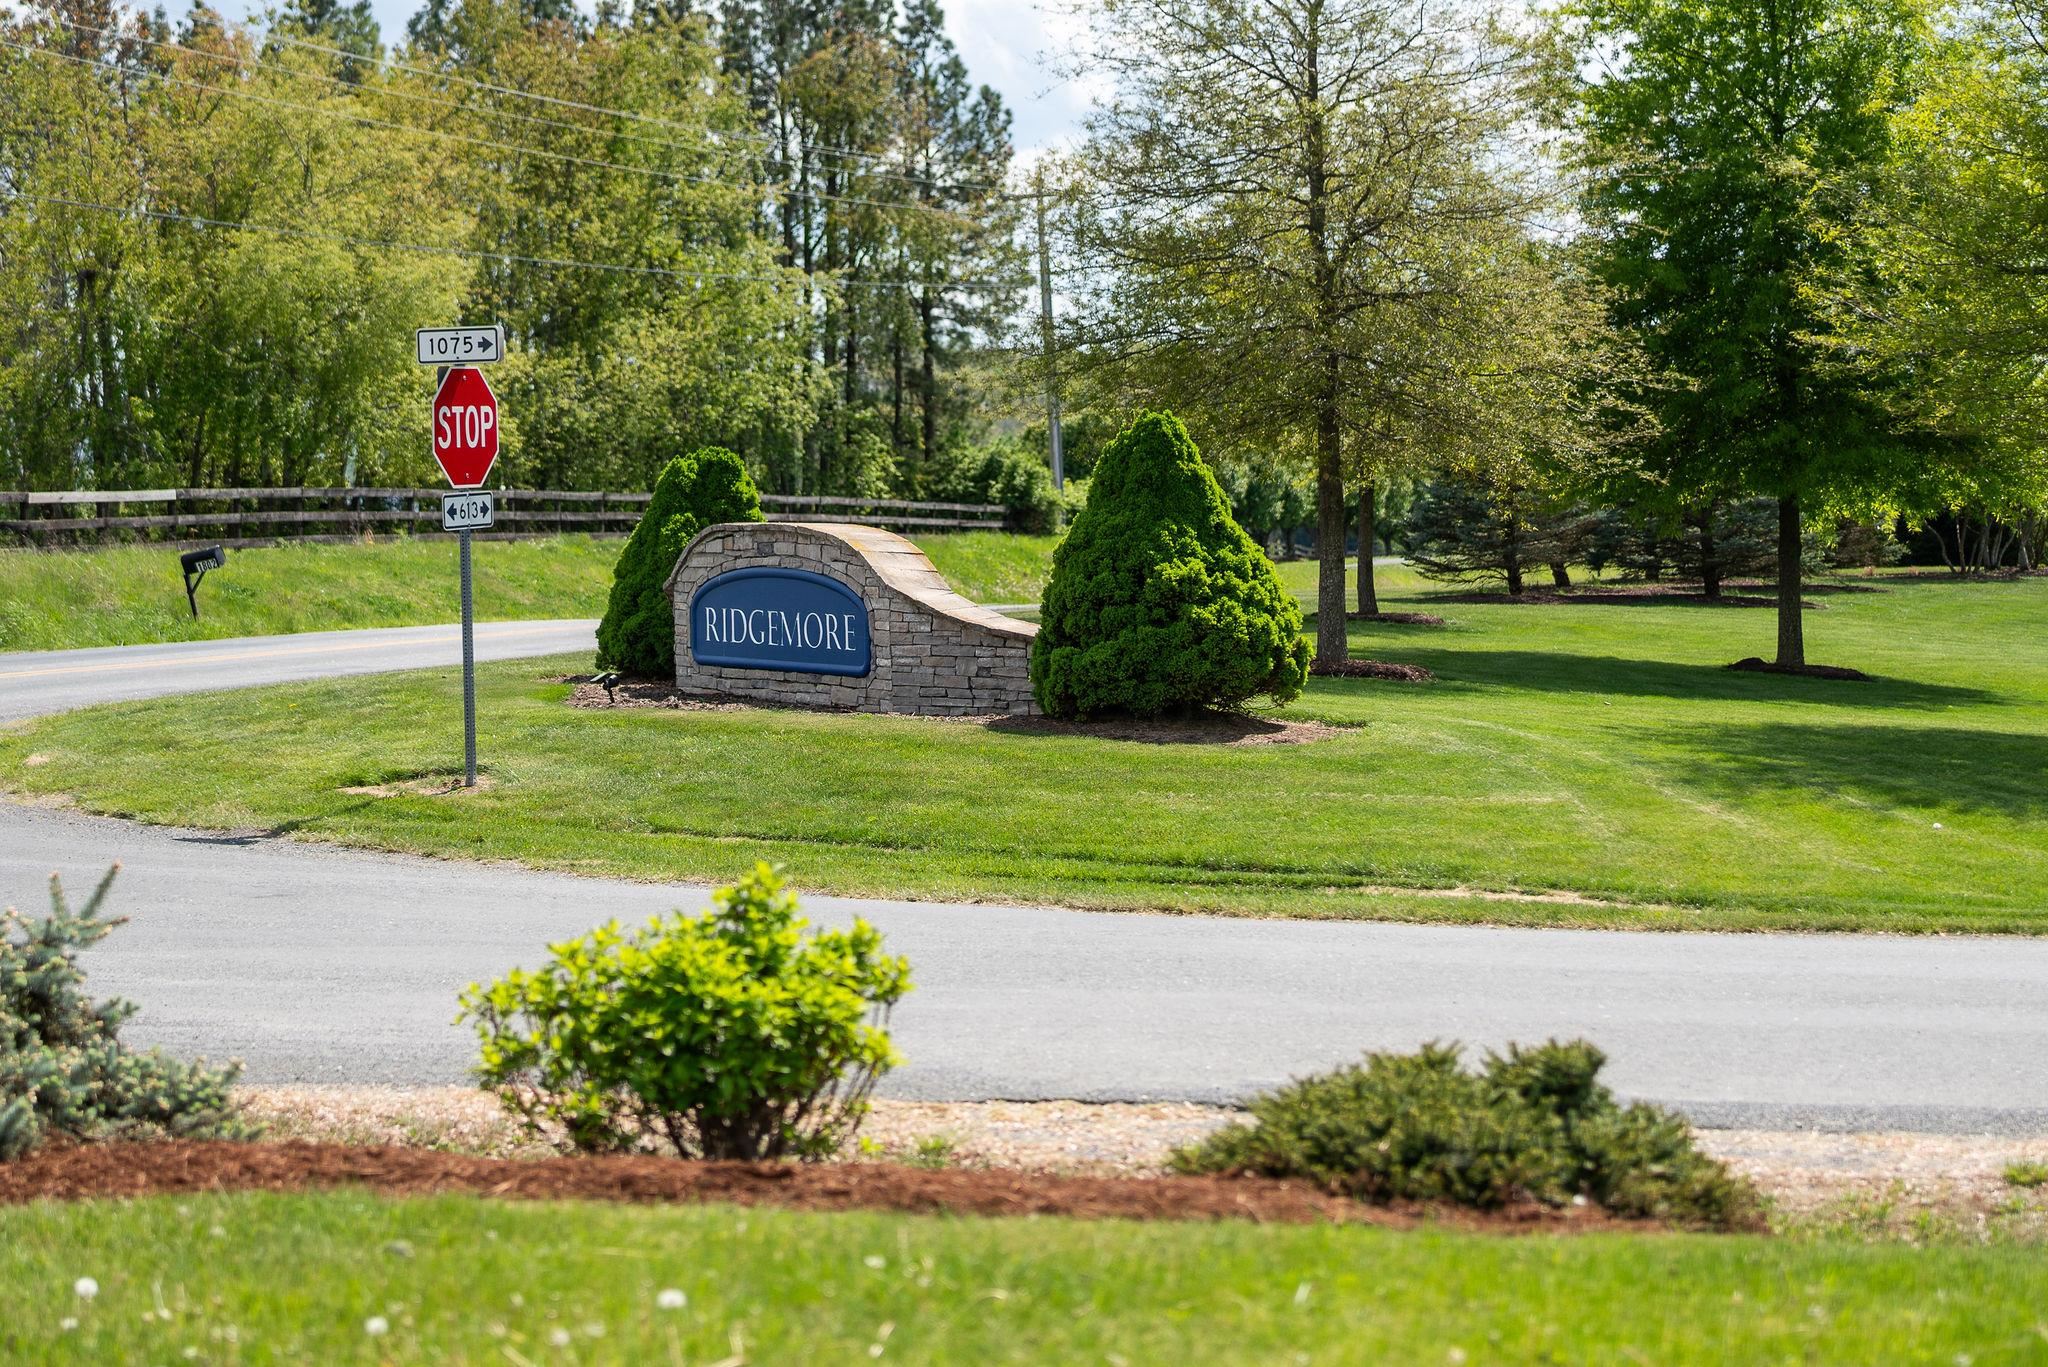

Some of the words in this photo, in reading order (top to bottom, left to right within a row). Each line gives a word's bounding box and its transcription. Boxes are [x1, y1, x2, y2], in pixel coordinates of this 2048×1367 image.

[429, 336, 473, 355] 1075
[438, 405, 494, 449] STOP
[459, 501, 479, 519] 613
[705, 607, 856, 651] RIDGEMORE
